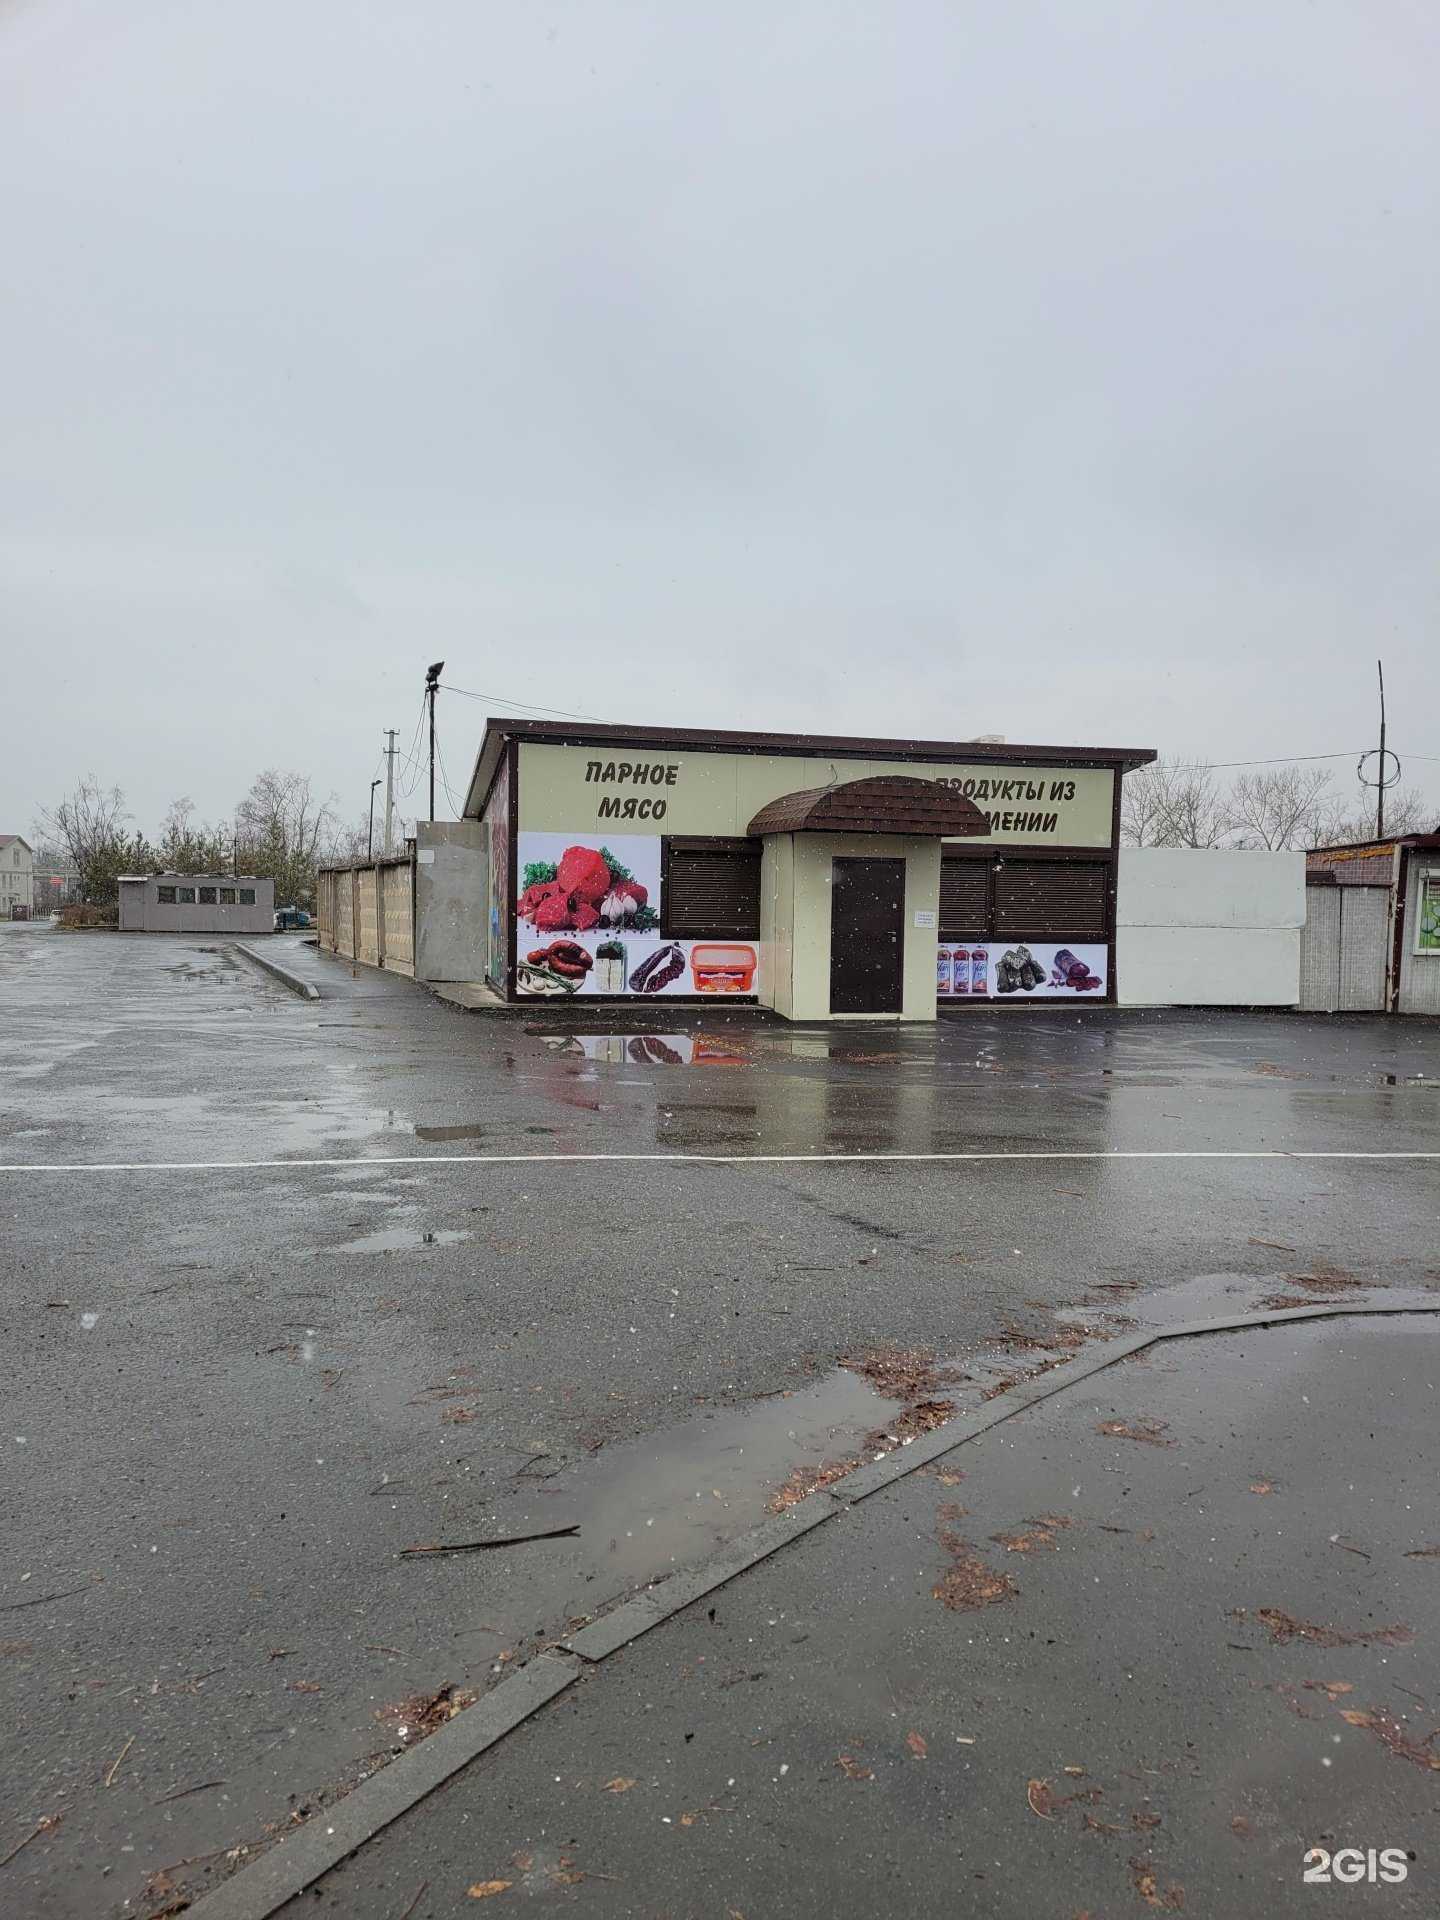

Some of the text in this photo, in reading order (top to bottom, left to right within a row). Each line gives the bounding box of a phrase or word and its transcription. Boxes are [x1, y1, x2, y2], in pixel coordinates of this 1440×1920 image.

[585, 761, 679, 785] ПАРНОЕ
[1050, 781, 1076, 801] ИЗ
[597, 797, 667, 820] МЯСО
[985, 811, 1058, 832] МЕНИИ
